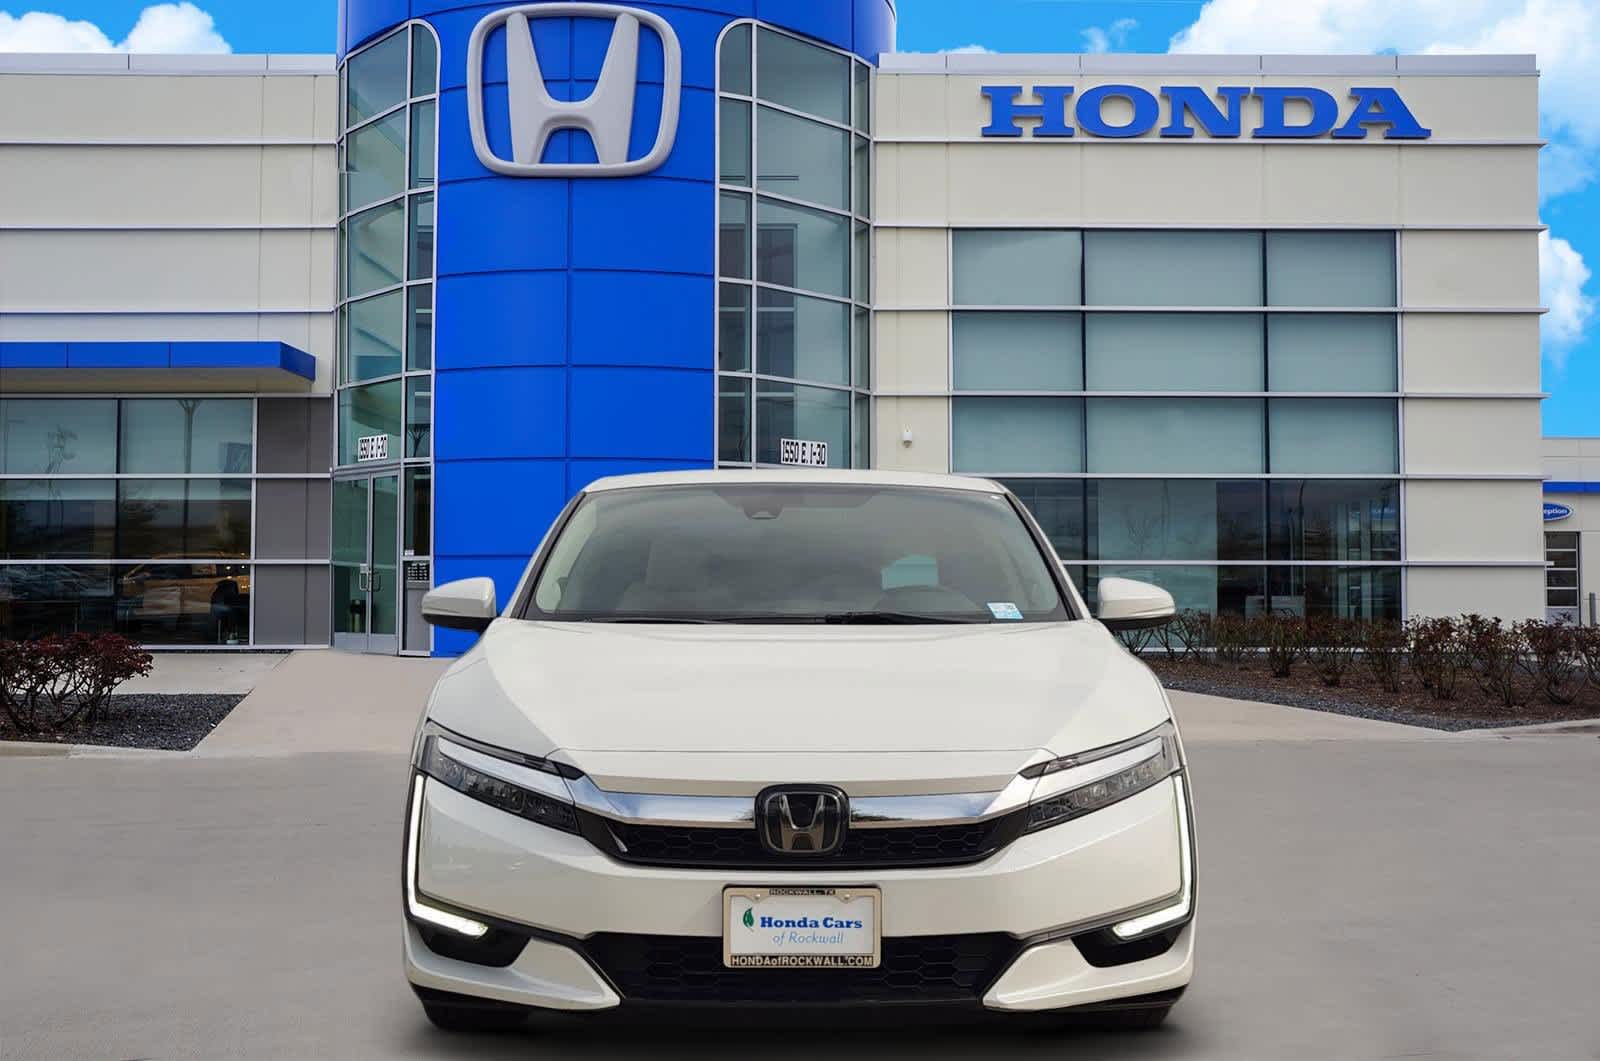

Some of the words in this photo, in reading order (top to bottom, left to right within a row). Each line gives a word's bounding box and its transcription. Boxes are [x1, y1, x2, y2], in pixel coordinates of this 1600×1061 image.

[981, 84, 1432, 139] HONDA
[782, 440, 800, 463] 1550
[810, 443, 826, 465] I-30
[760, 916, 819, 928] Honda
[822, 916, 863, 929] Cars
[772, 932, 785, 946] of
[788, 931, 845, 945] Rockwall
[731, 956, 873, 967] HONDAofROCKWALL.COM
